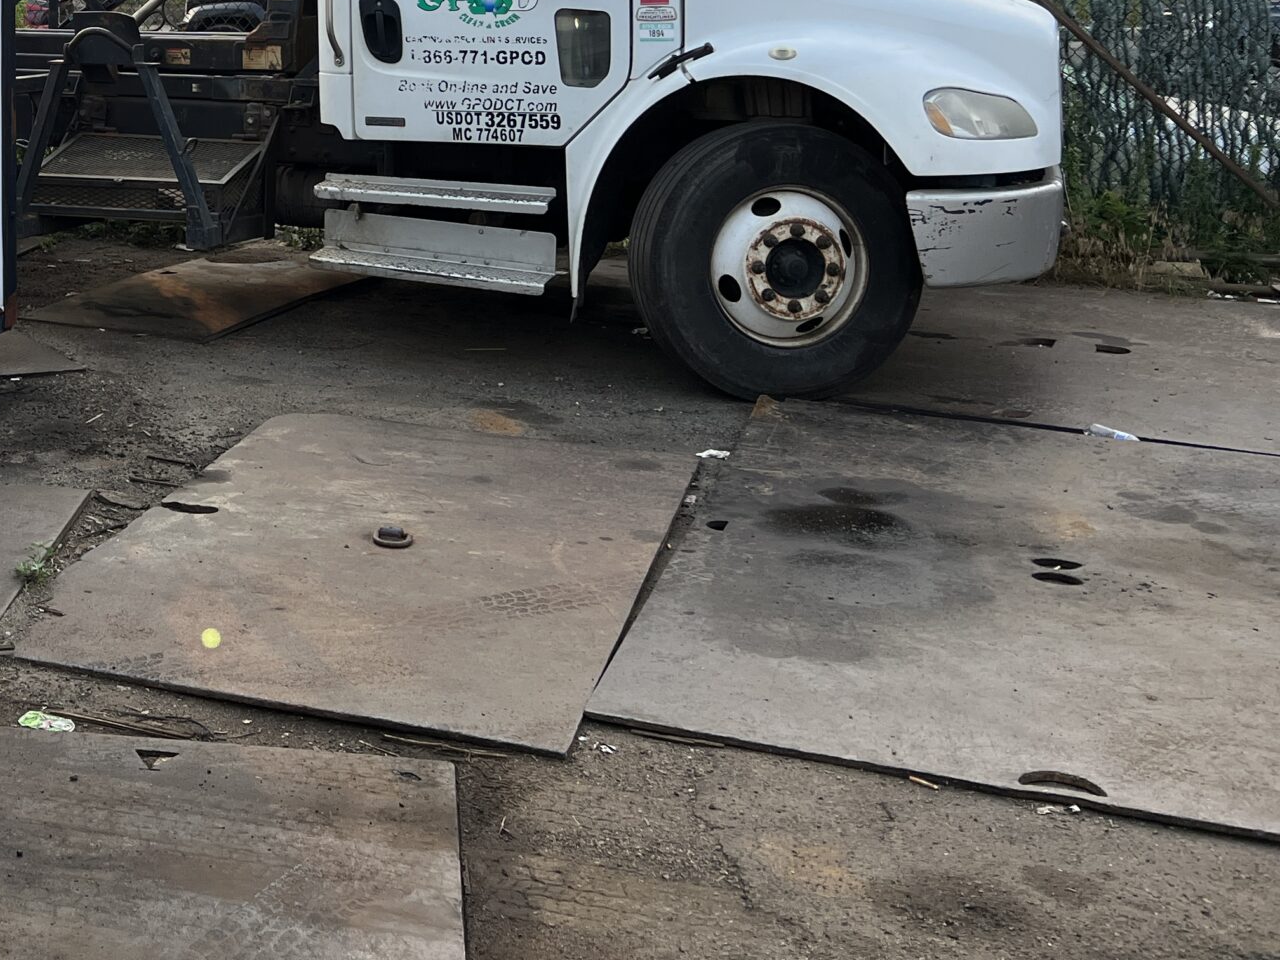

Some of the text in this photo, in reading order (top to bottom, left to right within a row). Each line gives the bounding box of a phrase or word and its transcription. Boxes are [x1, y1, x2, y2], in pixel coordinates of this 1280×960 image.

[649, 29, 664, 37] 1894
[492, 82, 518, 94] and
[522, 82, 558, 95] Save
[436, 112, 561, 130] USDOT 3267559
[453, 128, 524, 143] MC 774607
